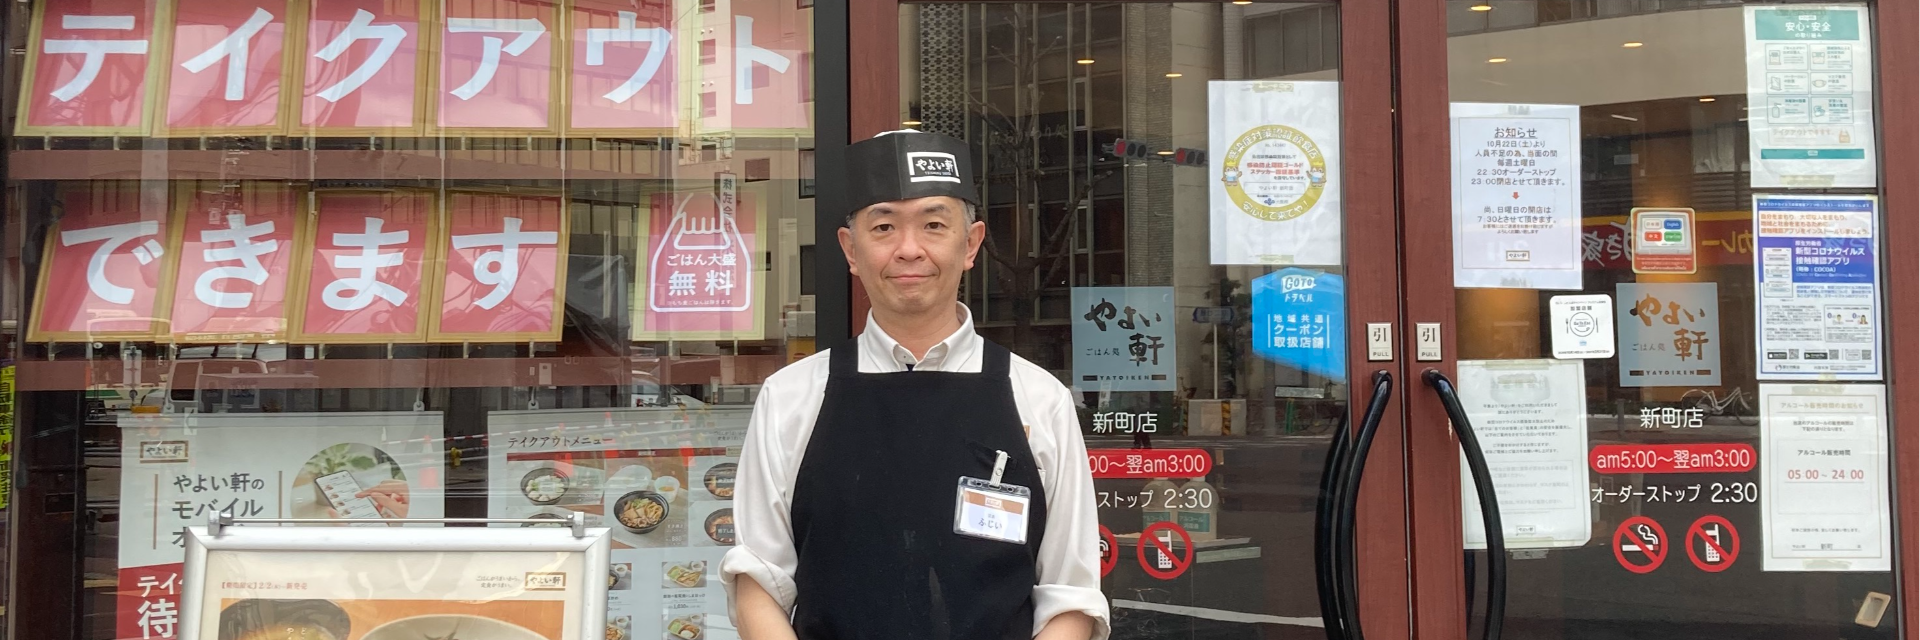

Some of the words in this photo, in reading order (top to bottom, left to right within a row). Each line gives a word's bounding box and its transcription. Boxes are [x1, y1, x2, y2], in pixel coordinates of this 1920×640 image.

[1785, 22, 1831, 31] 安心・安全
[43, 8, 790, 106] テイクアウト
[1494, 127, 1537, 138] お知らせ
[915, 158, 954, 173] やよい軒
[1796, 247, 1865, 255] 新型コロナウイルス
[61, 214, 558, 309] できます
[666, 253, 737, 266] ごはん大盛
[1796, 257, 1850, 265] 接触確認アプリ
[668, 270, 734, 296] 無料
[1284, 294, 1313, 302] トラベル
[1085, 298, 1161, 332] やよい
[1630, 293, 1705, 326] やよい
[1273, 314, 1323, 323] 地域共通
[1273, 324, 1324, 335] クーポン
[1373, 328, 1387, 342] 引
[1422, 328, 1436, 342] 引
[1273, 337, 1324, 348] 取扱店舗
[1674, 328, 1709, 361] 軒
[1092, 411, 1157, 433] 新町店
[1640, 407, 1704, 429] 新町店
[507, 436, 613, 448] テイクアウトメニュー
[173, 472, 265, 493] やよい軒の
[1097, 489, 1153, 508] ストップ
[1163, 488, 1212, 508] 2:30
[1591, 484, 1701, 503] オーダーストップ
[1710, 483, 1758, 503] 2:30
[172, 498, 263, 519] モバイル
[530, 576, 561, 584] やよい軒
[137, 598, 178, 640] 待
